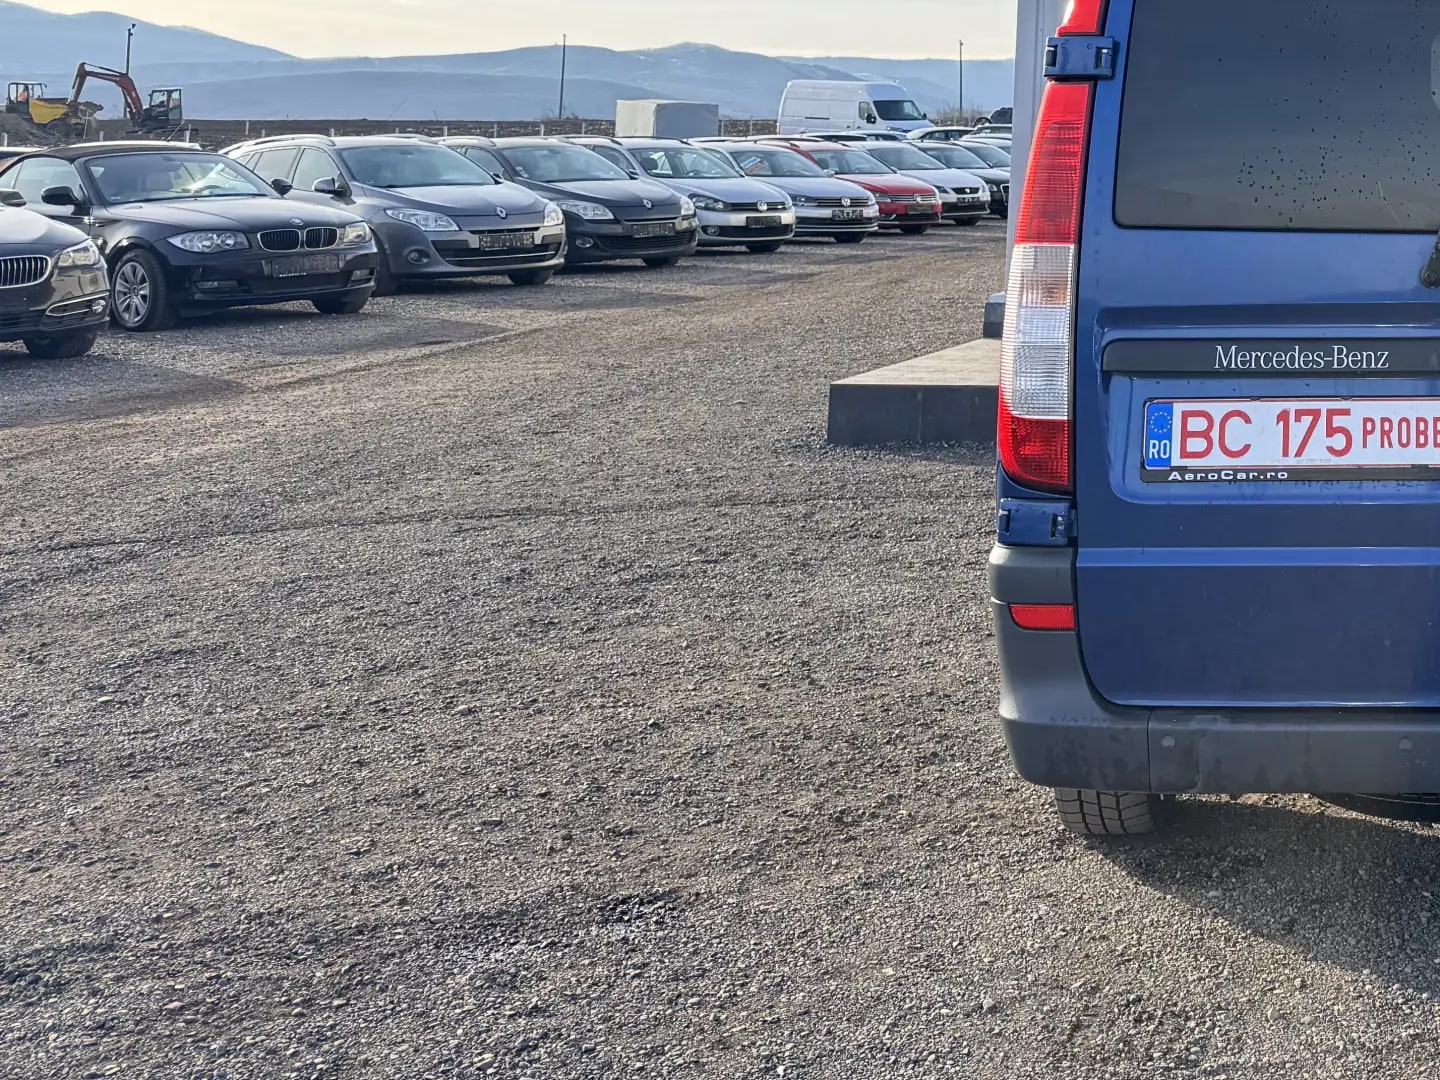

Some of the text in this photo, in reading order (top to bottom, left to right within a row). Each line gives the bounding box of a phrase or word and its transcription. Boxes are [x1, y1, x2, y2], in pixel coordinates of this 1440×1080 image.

[1214, 345, 1389, 369] Mercedes-Benz
[1180, 409, 1253, 460] BC
[1276, 408, 1353, 458] 175
[1149, 439, 1171, 459] RO
[1168, 469, 1289, 482] AeroCar.ro
